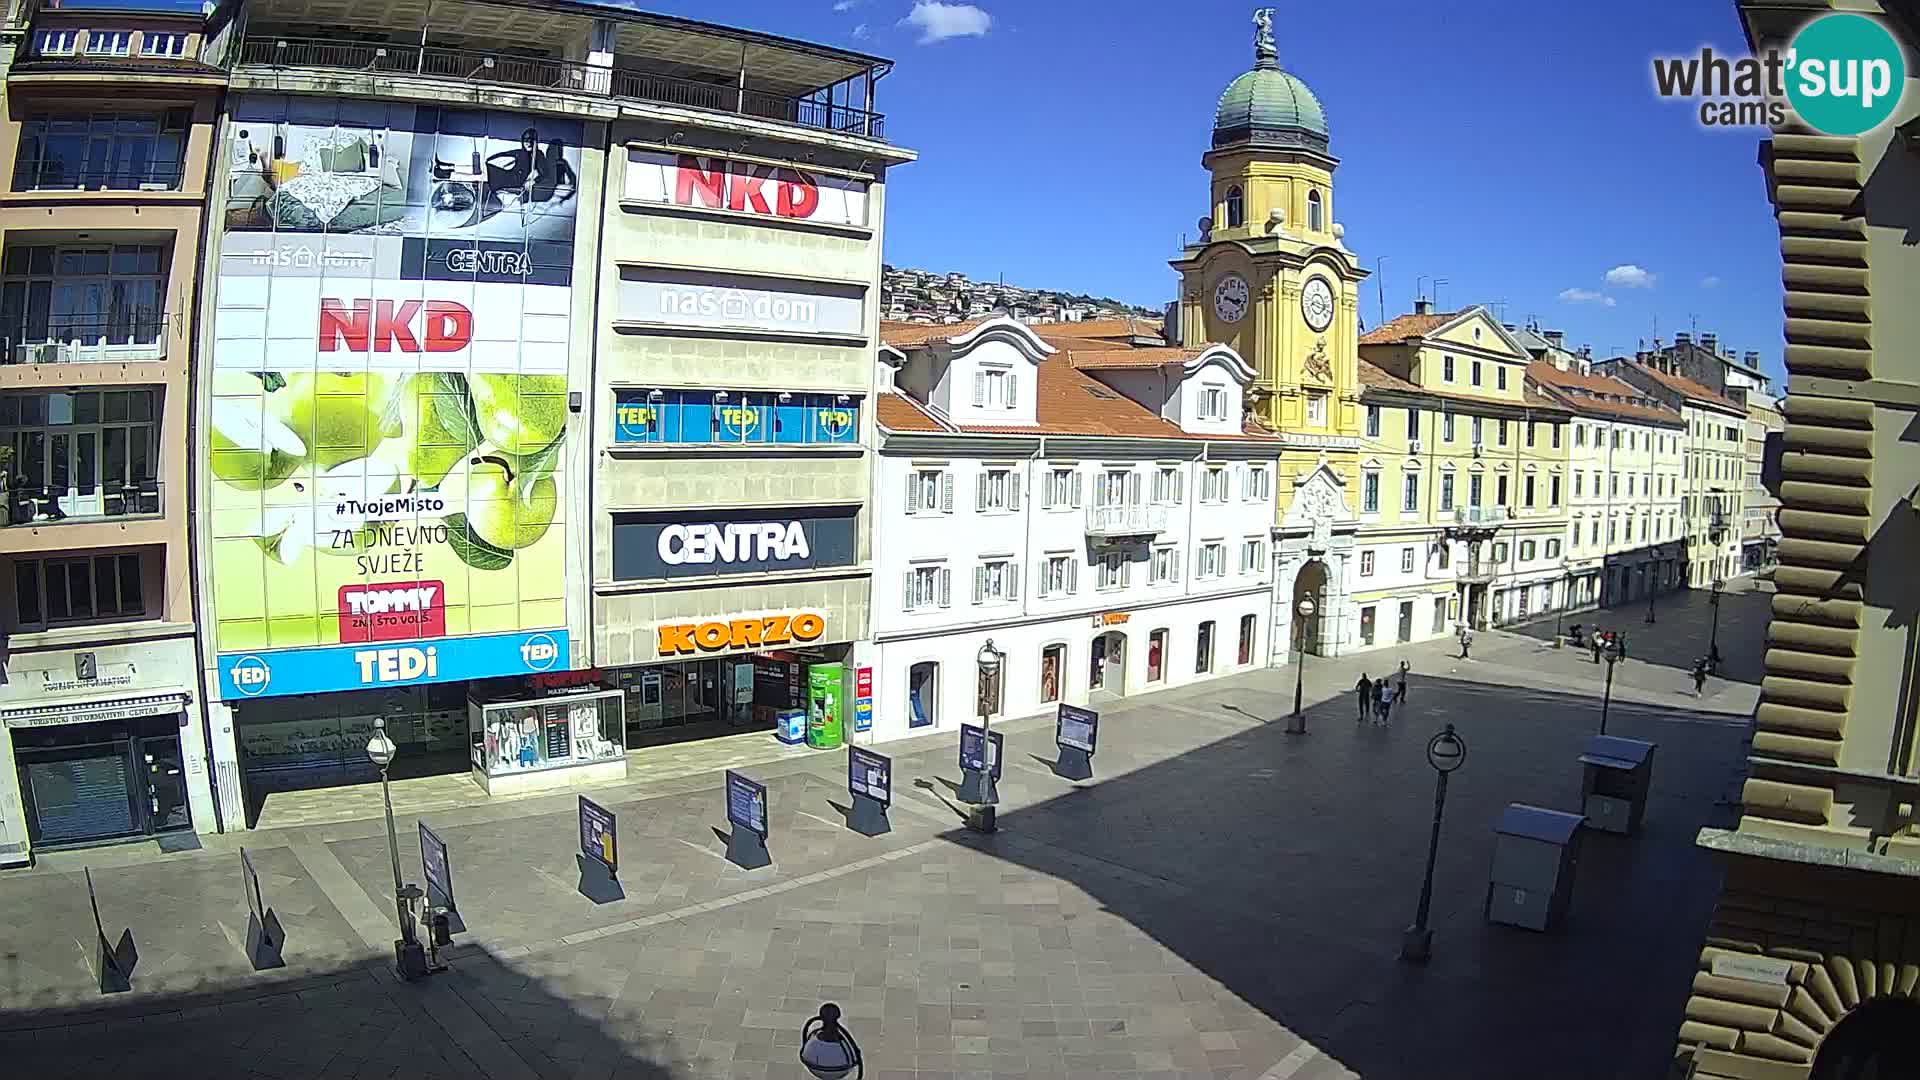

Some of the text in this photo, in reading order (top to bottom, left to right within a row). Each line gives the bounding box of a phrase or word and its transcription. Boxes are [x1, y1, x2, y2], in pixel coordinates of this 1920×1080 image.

[675, 154, 819, 218] NKD
[446, 248, 533, 275] CENTRA
[753, 293, 816, 321] dom
[319, 298, 474, 352] NKD
[722, 409, 759, 426] TEDi
[336, 498, 444, 516] #TvojeMisto
[331, 525, 449, 549] ZA DNEVNO
[657, 520, 810, 565] CENTRA
[357, 549, 424, 575] SVJEŽE
[345, 587, 438, 615] TOMMY
[658, 613, 825, 656] KORZO
[355, 646, 438, 683] TEDi
[520, 643, 558, 661] TEDi
[231, 667, 271, 685] TEDi
